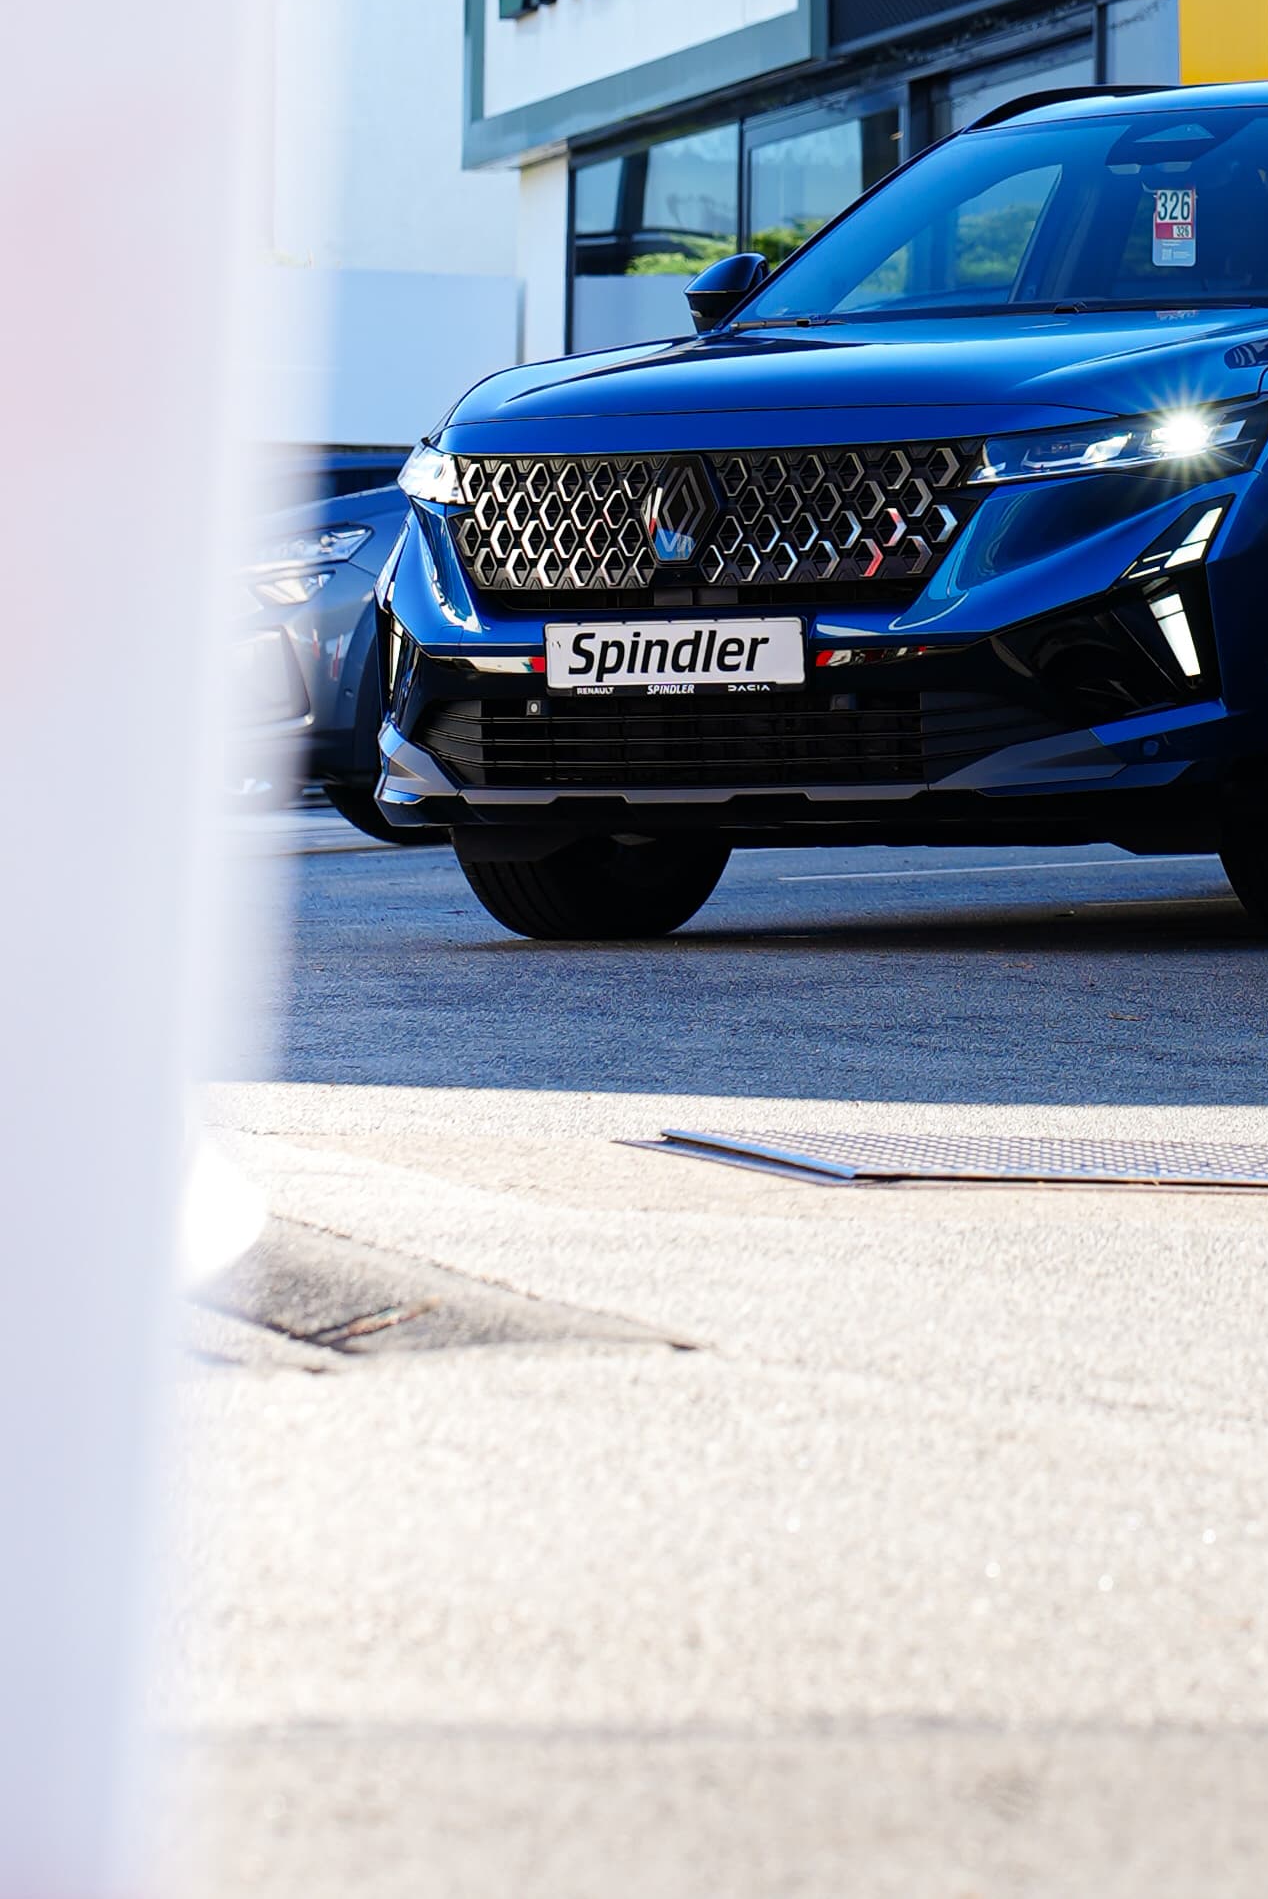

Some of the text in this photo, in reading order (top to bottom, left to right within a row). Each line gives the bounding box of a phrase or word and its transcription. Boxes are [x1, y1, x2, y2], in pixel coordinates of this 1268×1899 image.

[1158, 192, 1190, 220] 326
[568, 630, 769, 682] Spindler
[576, 683, 770, 695] RENAULT SPINDLER DACIA
